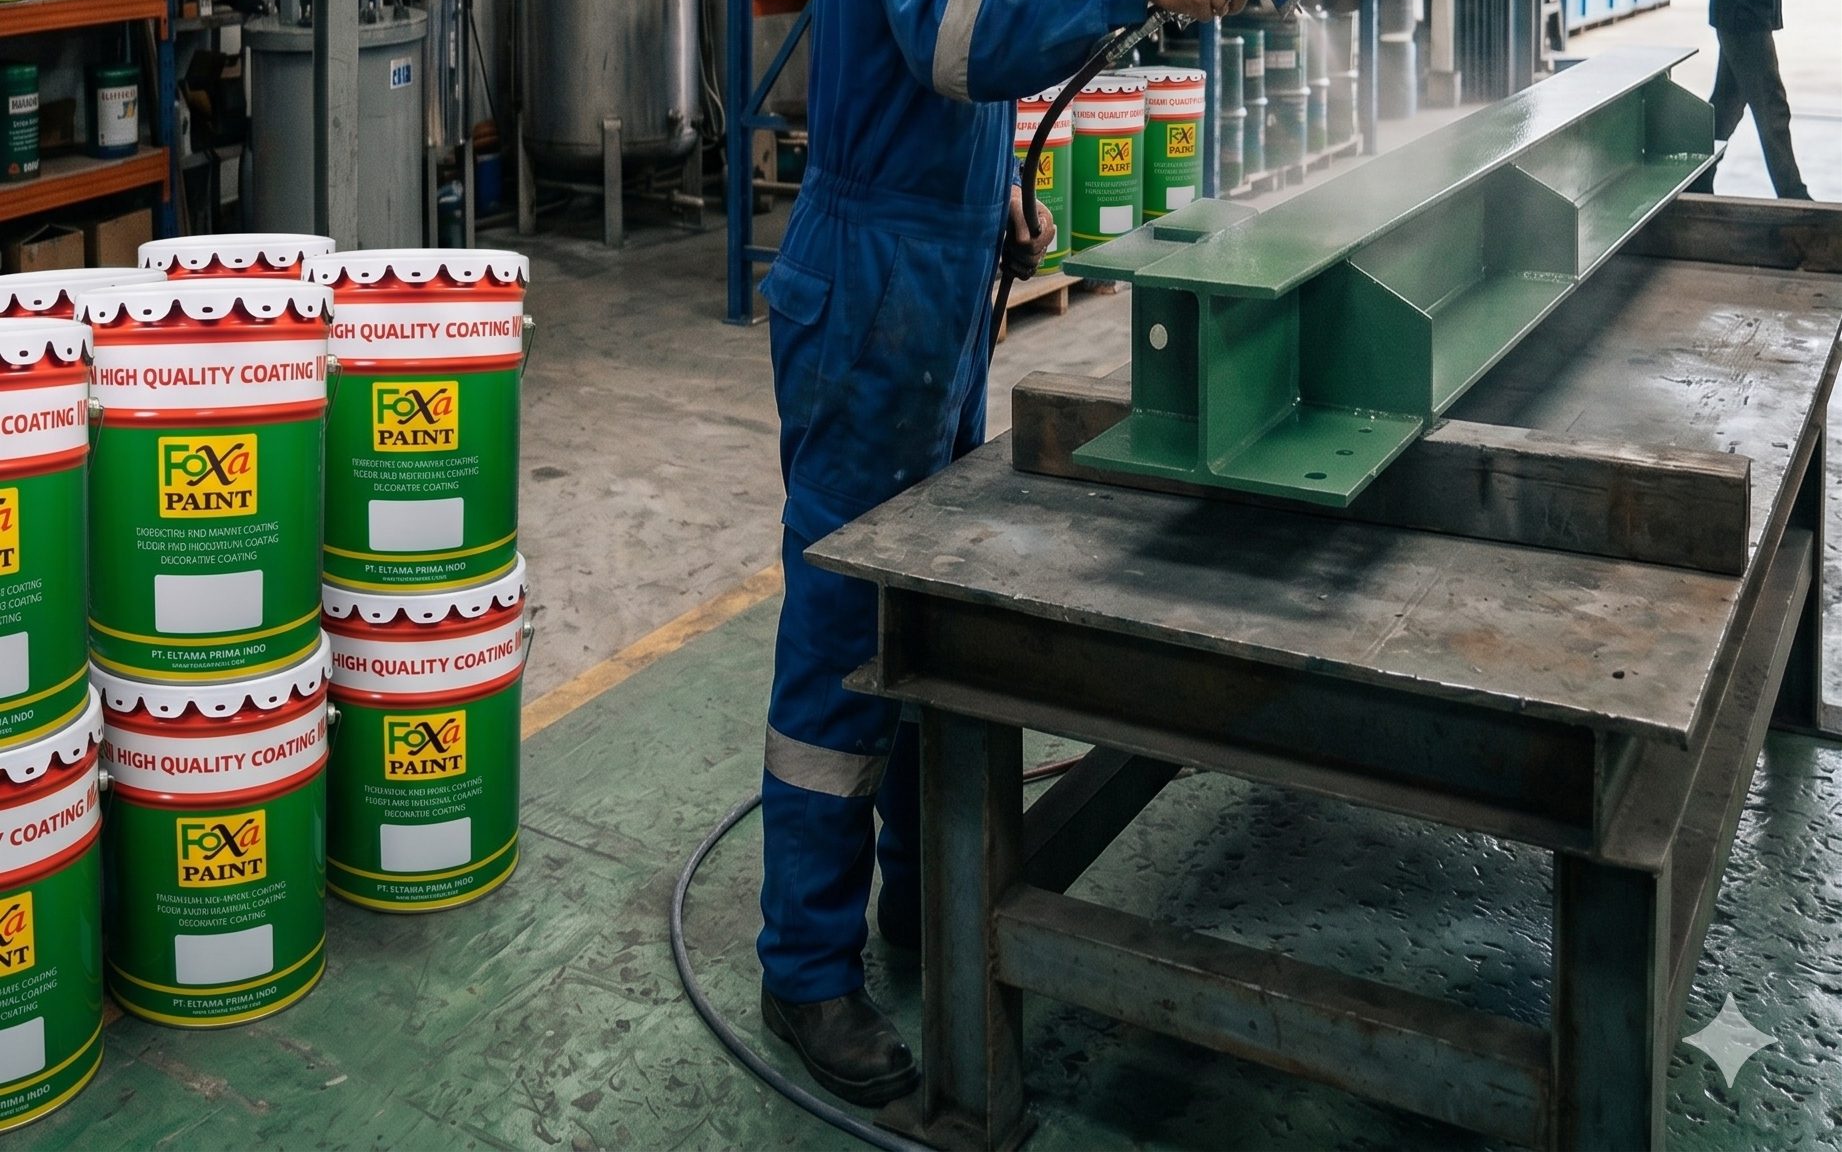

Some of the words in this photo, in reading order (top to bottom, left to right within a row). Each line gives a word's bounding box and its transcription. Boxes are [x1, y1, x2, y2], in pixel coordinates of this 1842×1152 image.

[329, 323, 355, 339] IGH
[360, 322, 440, 342] QUALITY
[446, 320, 510, 338] COATING
[101, 368, 137, 386] HIGH
[143, 366, 235, 389] QUALITY
[240, 361, 313, 383] COATING
[1, 408, 75, 435] COATING
[378, 428, 454, 445] PAINT
[165, 490, 252, 511] PAINT
[379, 566, 414, 575] ELTAMA
[416, 565, 444, 574] PRIMA
[151, 650, 165, 659] PT.
[167, 651, 207, 660] ELTAMA
[209, 649, 241, 659] PRIMA
[243, 644, 266, 655] INDO
[332, 652, 367, 672] HIGH
[371, 657, 450, 677] QUALITY
[454, 639, 513, 671] COATING
[11, 709, 34, 724] INDO
[117, 747, 156, 771] HIGH
[160, 753, 247, 776] QUALITY
[251, 728, 316, 767] COATING
[389, 755, 463, 775] PAINT
[10, 799, 84, 846] COATING
[182, 858, 263, 881] PAINT
[230, 910, 266, 925] COATING
[187, 999, 224, 1008] ELTAMA
[226, 993, 254, 1005] PRIMA
[256, 986, 277, 999] INDO
